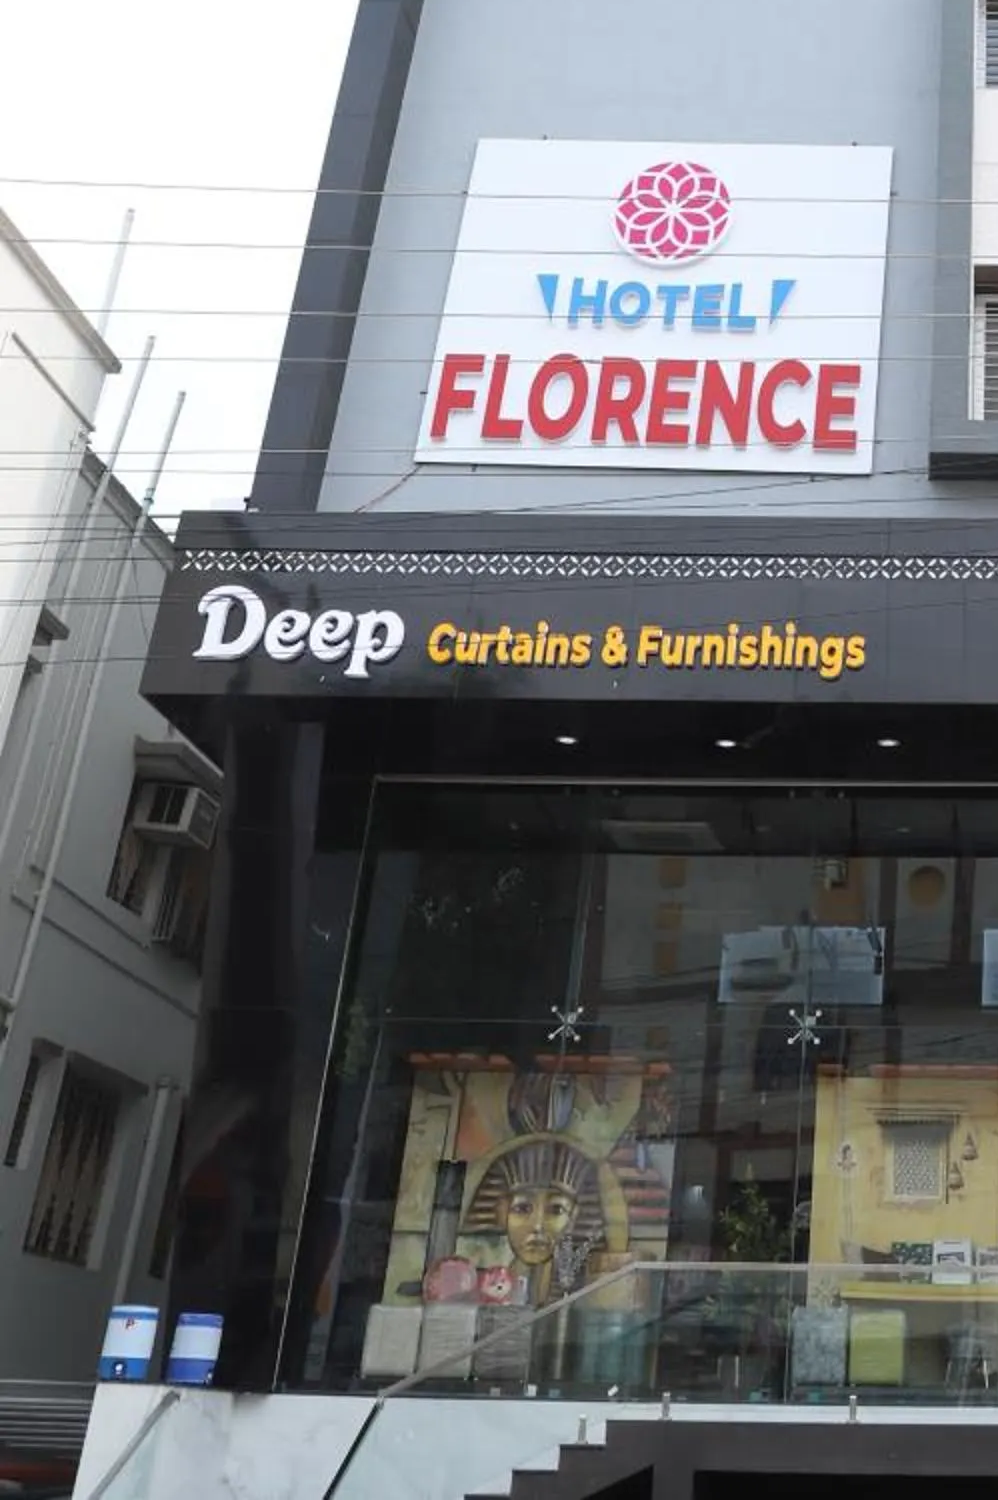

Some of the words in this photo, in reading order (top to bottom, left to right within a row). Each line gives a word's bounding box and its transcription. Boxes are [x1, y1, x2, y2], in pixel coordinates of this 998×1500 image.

[566, 276, 757, 332] HOTEL
[430, 353, 861, 452] FLORENCE
[192, 585, 405, 678] Deep
[426, 621, 592, 666] Curtains
[600, 624, 628, 667] &
[636, 621, 866, 678] Furnishings
